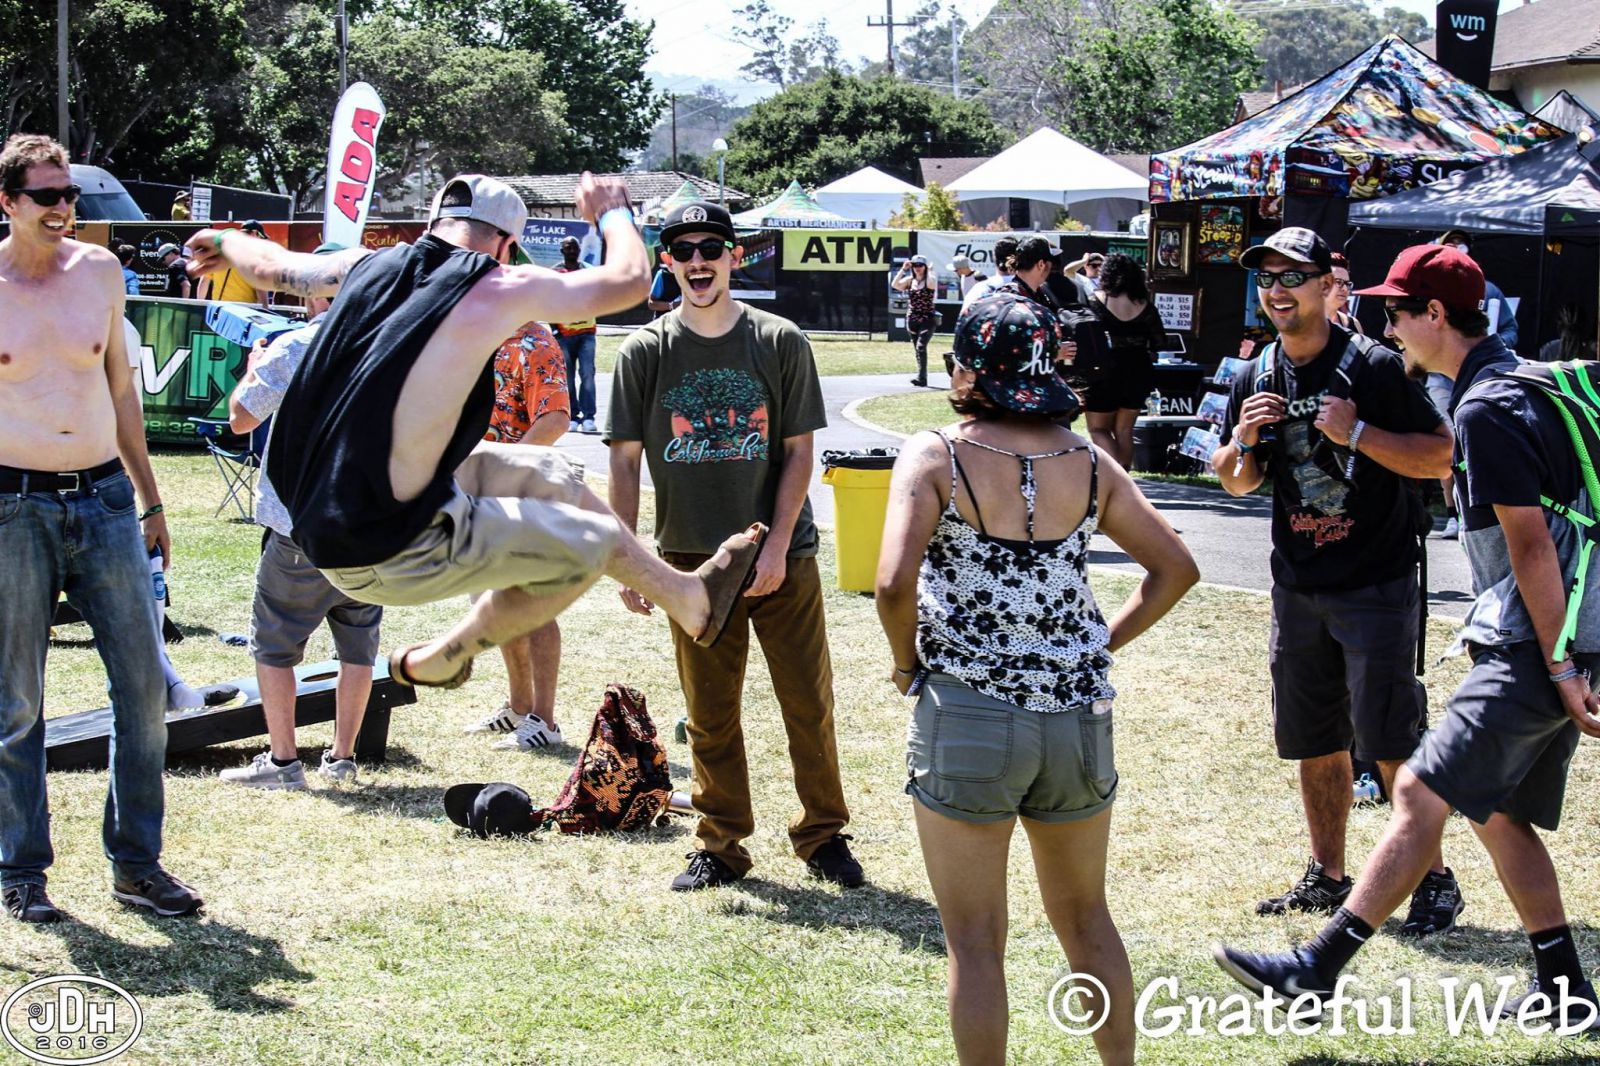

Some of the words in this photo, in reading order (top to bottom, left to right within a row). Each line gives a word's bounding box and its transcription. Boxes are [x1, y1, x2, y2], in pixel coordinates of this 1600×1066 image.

[1450, 14, 1486, 31] wm
[333, 107, 381, 224] ADA
[526, 224, 541, 234] The
[542, 226, 566, 235] LAKE
[767, 218, 798, 227] ARTIST
[802, 219, 863, 228] MERCHANDISE
[799, 236, 892, 264] ATM
[1018, 340, 1055, 376] hi
